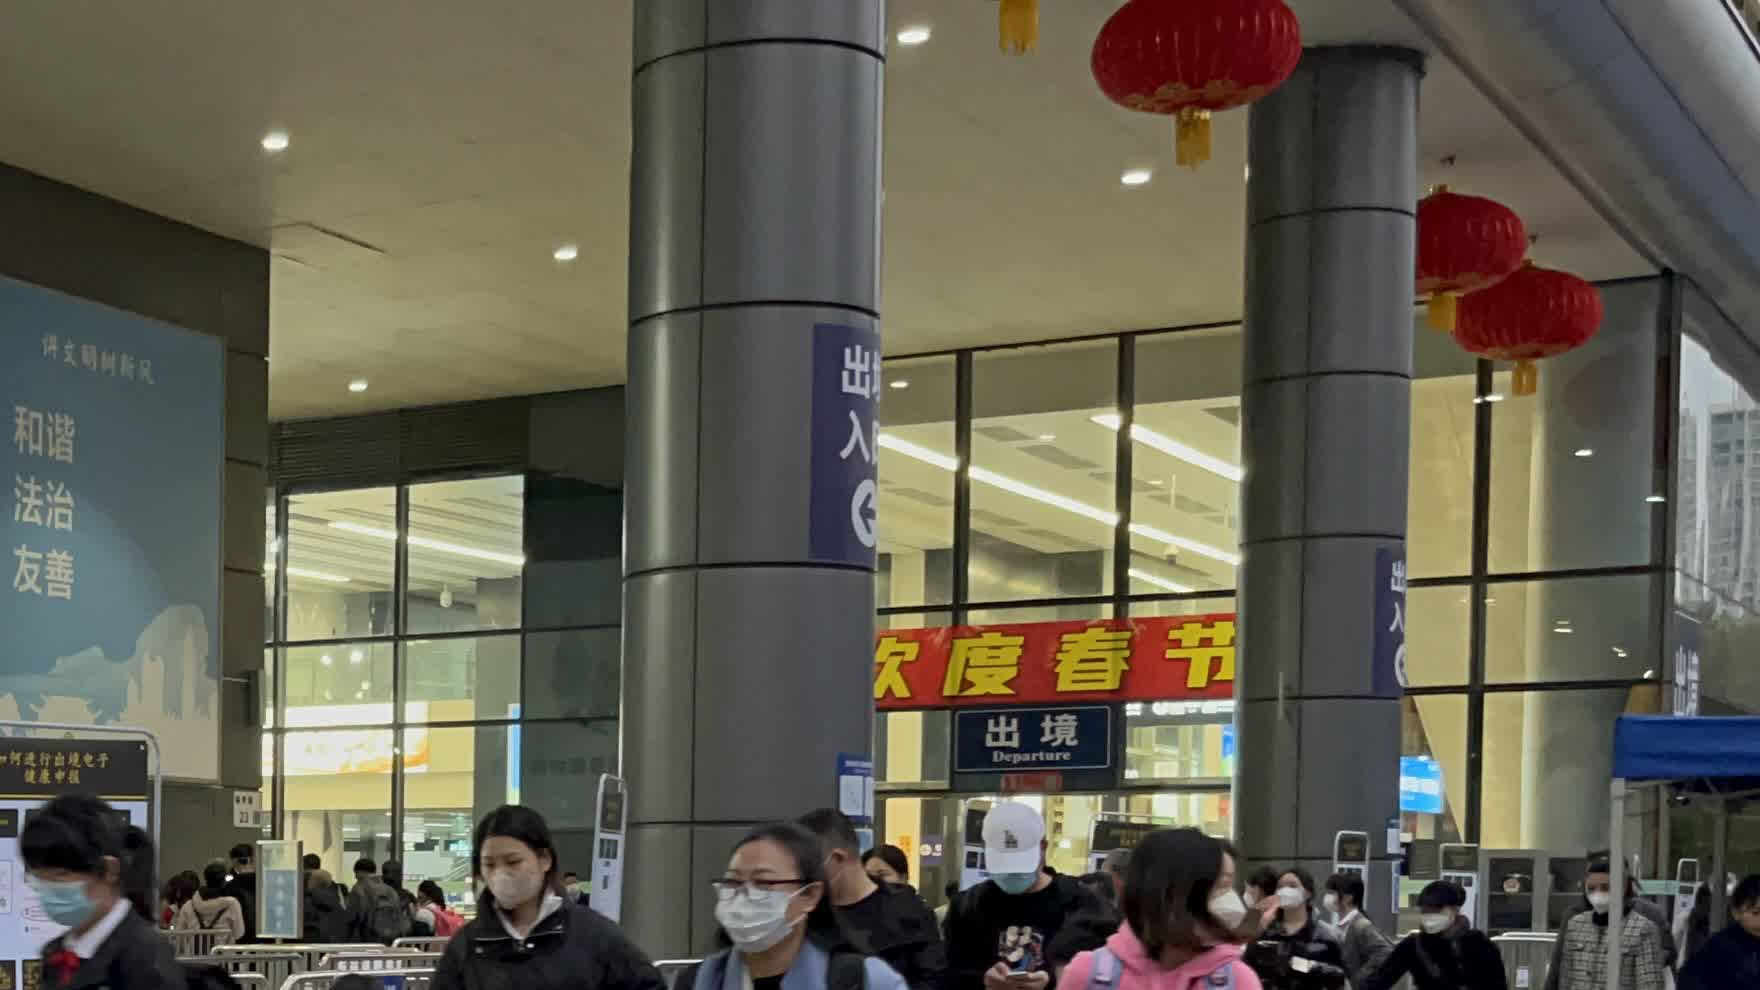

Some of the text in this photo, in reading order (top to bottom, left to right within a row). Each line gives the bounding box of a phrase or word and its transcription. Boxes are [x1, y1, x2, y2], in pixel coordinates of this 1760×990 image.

[14, 404, 76, 464] 和谐
[13, 474, 75, 532] 法治
[12, 544, 75, 600] 友善
[984, 713, 1079, 750] 出境
[991, 750, 1072, 764] Departure
